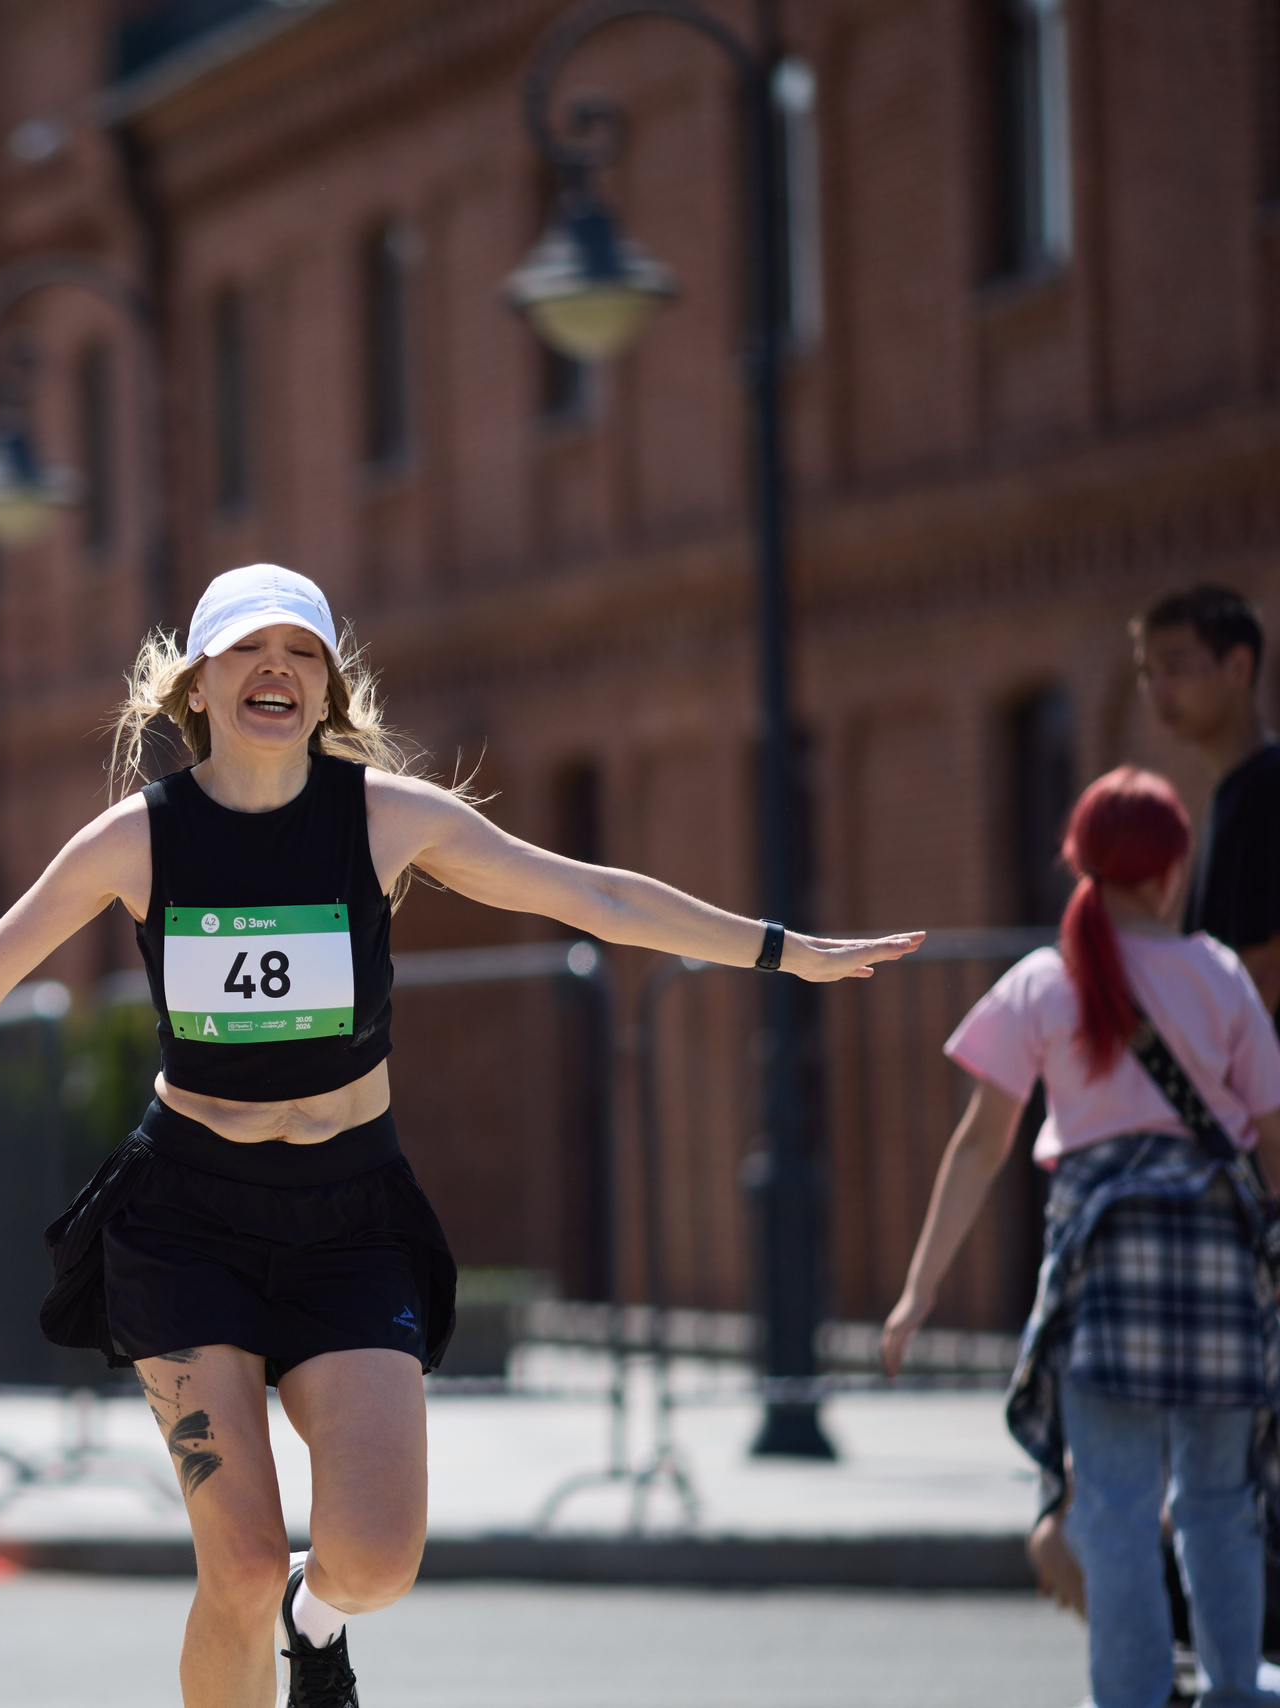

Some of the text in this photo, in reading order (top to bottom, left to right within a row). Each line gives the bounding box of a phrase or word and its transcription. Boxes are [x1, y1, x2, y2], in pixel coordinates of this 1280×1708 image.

[204, 917, 216, 927] 4,2
[248, 918, 277, 929] Звук
[224, 950, 291, 999] 48
[357, 1025, 375, 1043] FILA
